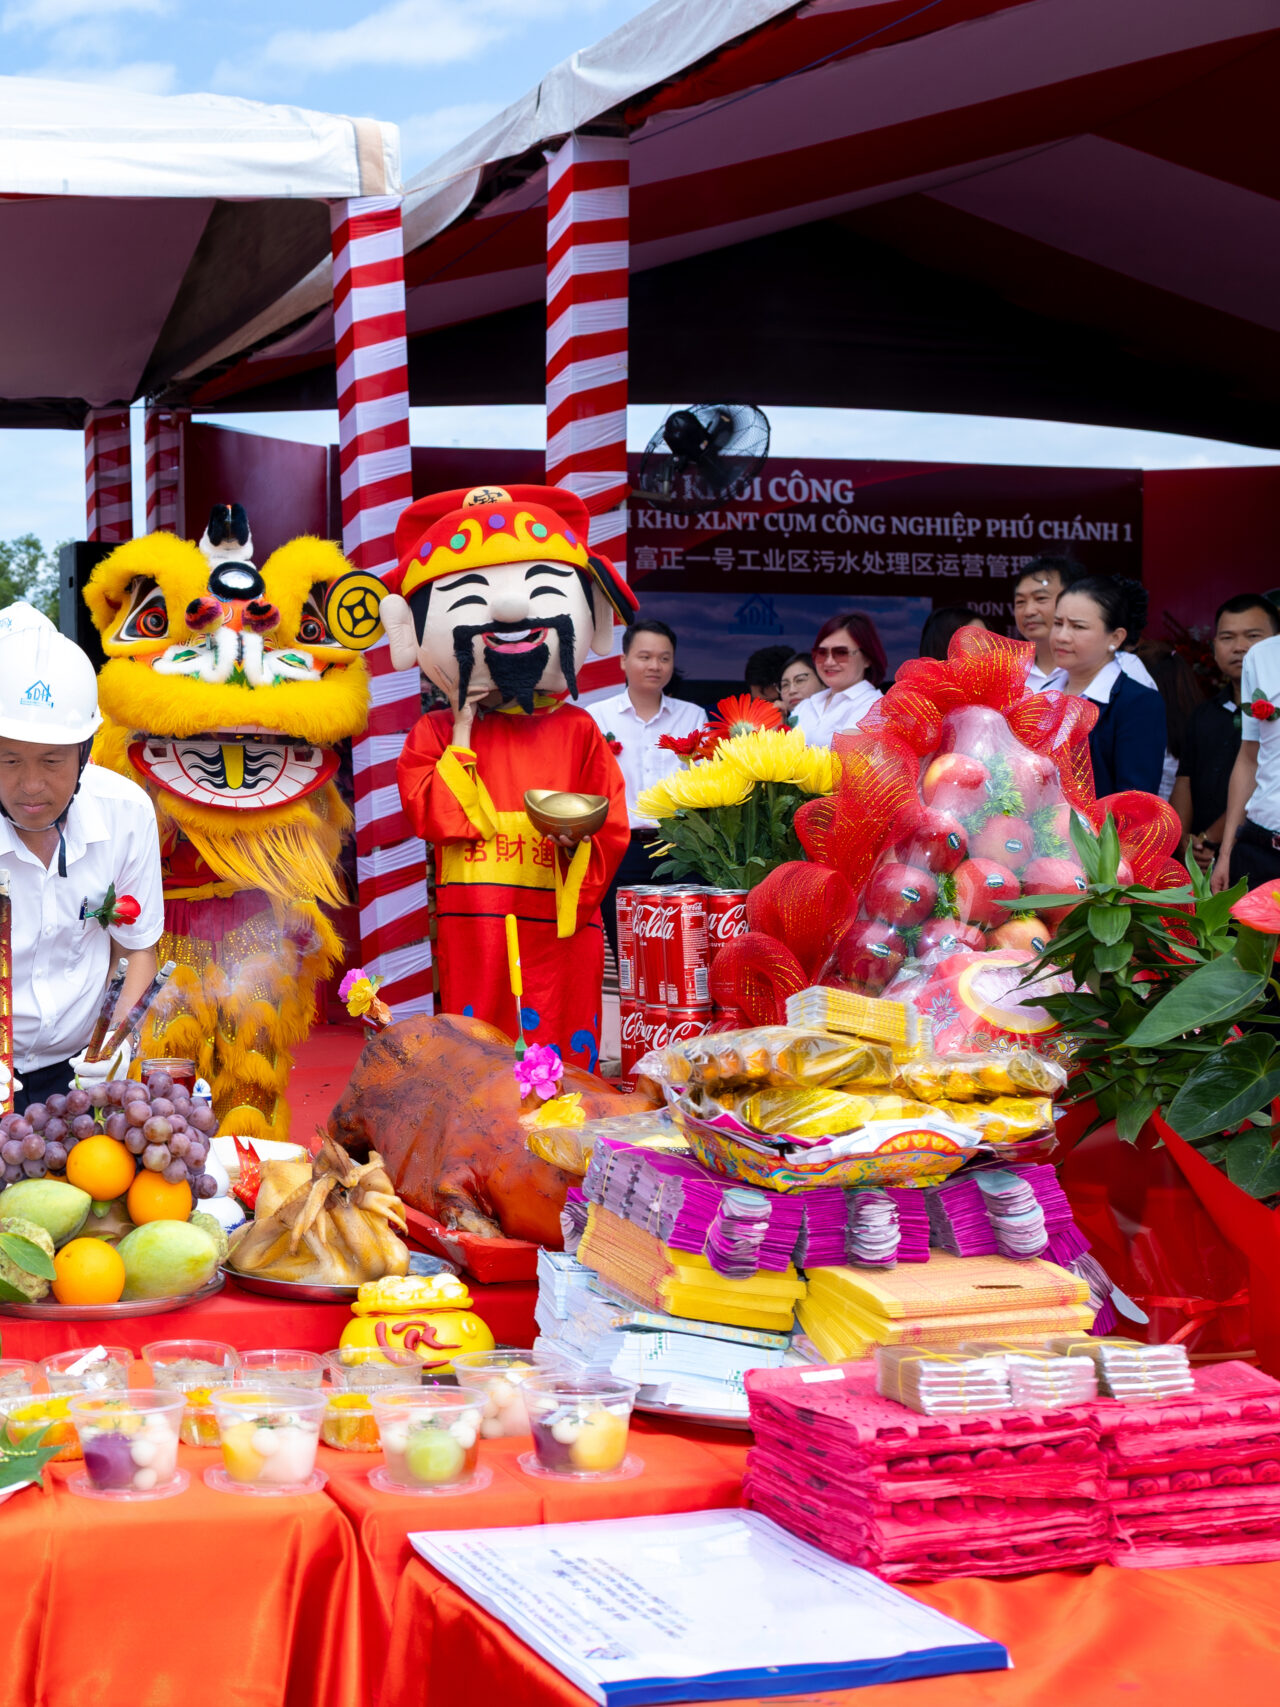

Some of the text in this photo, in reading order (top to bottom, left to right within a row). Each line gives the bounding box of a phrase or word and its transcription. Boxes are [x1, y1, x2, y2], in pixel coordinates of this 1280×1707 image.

[768, 468, 855, 505] CÔNG
[637, 509, 689, 530] KHU
[694, 510, 759, 531] XLNT
[764, 512, 817, 539] CỤM
[821, 507, 886, 536] CÔNG
[891, 511, 982, 543] NGHIỆP
[986, 512, 1035, 540] PHÚ
[1038, 514, 1119, 542] CHÁNH
[1123, 522, 1134, 543] 1
[634, 545, 1042, 579] 富正一号工业区污水处理区运营管理
